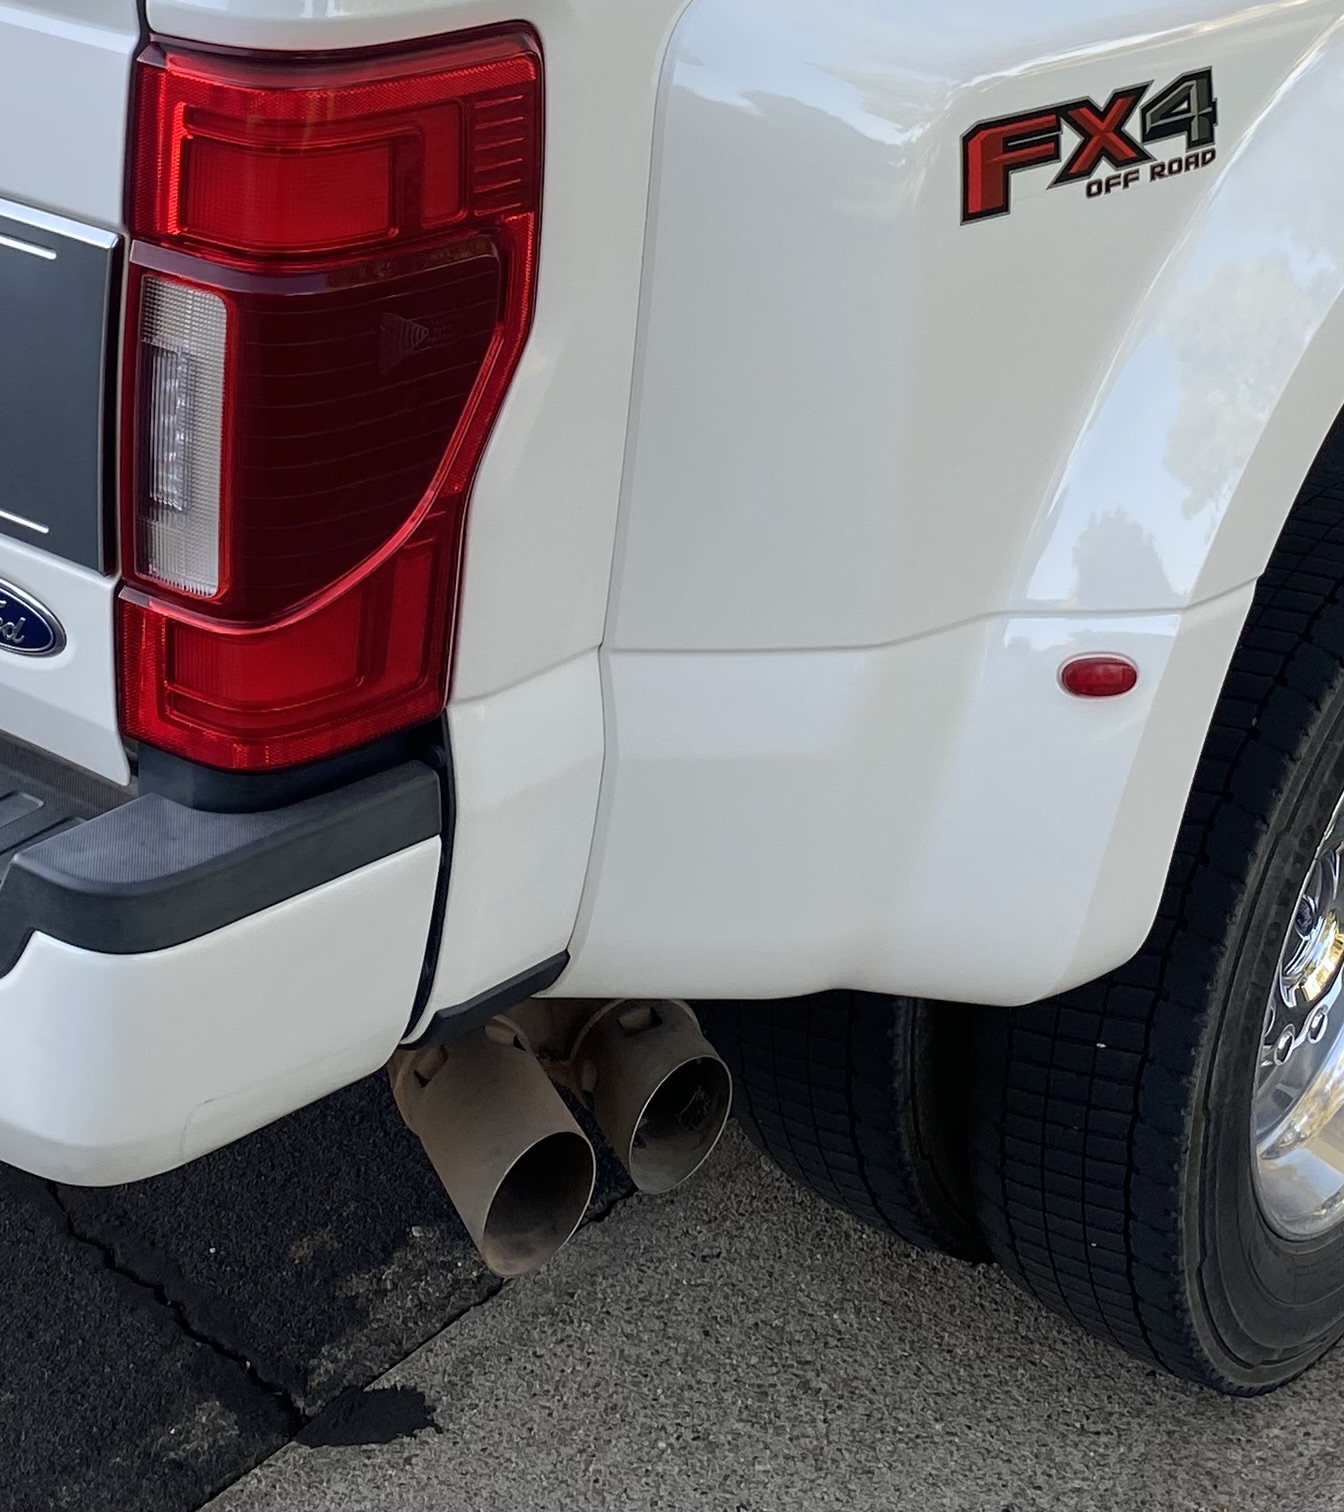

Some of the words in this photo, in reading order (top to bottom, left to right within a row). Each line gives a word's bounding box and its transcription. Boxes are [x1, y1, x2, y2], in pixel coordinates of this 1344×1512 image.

[960, 66, 1218, 226] FX4
[1085, 168, 1140, 199] OFF
[1149, 148, 1217, 183] ROAD
